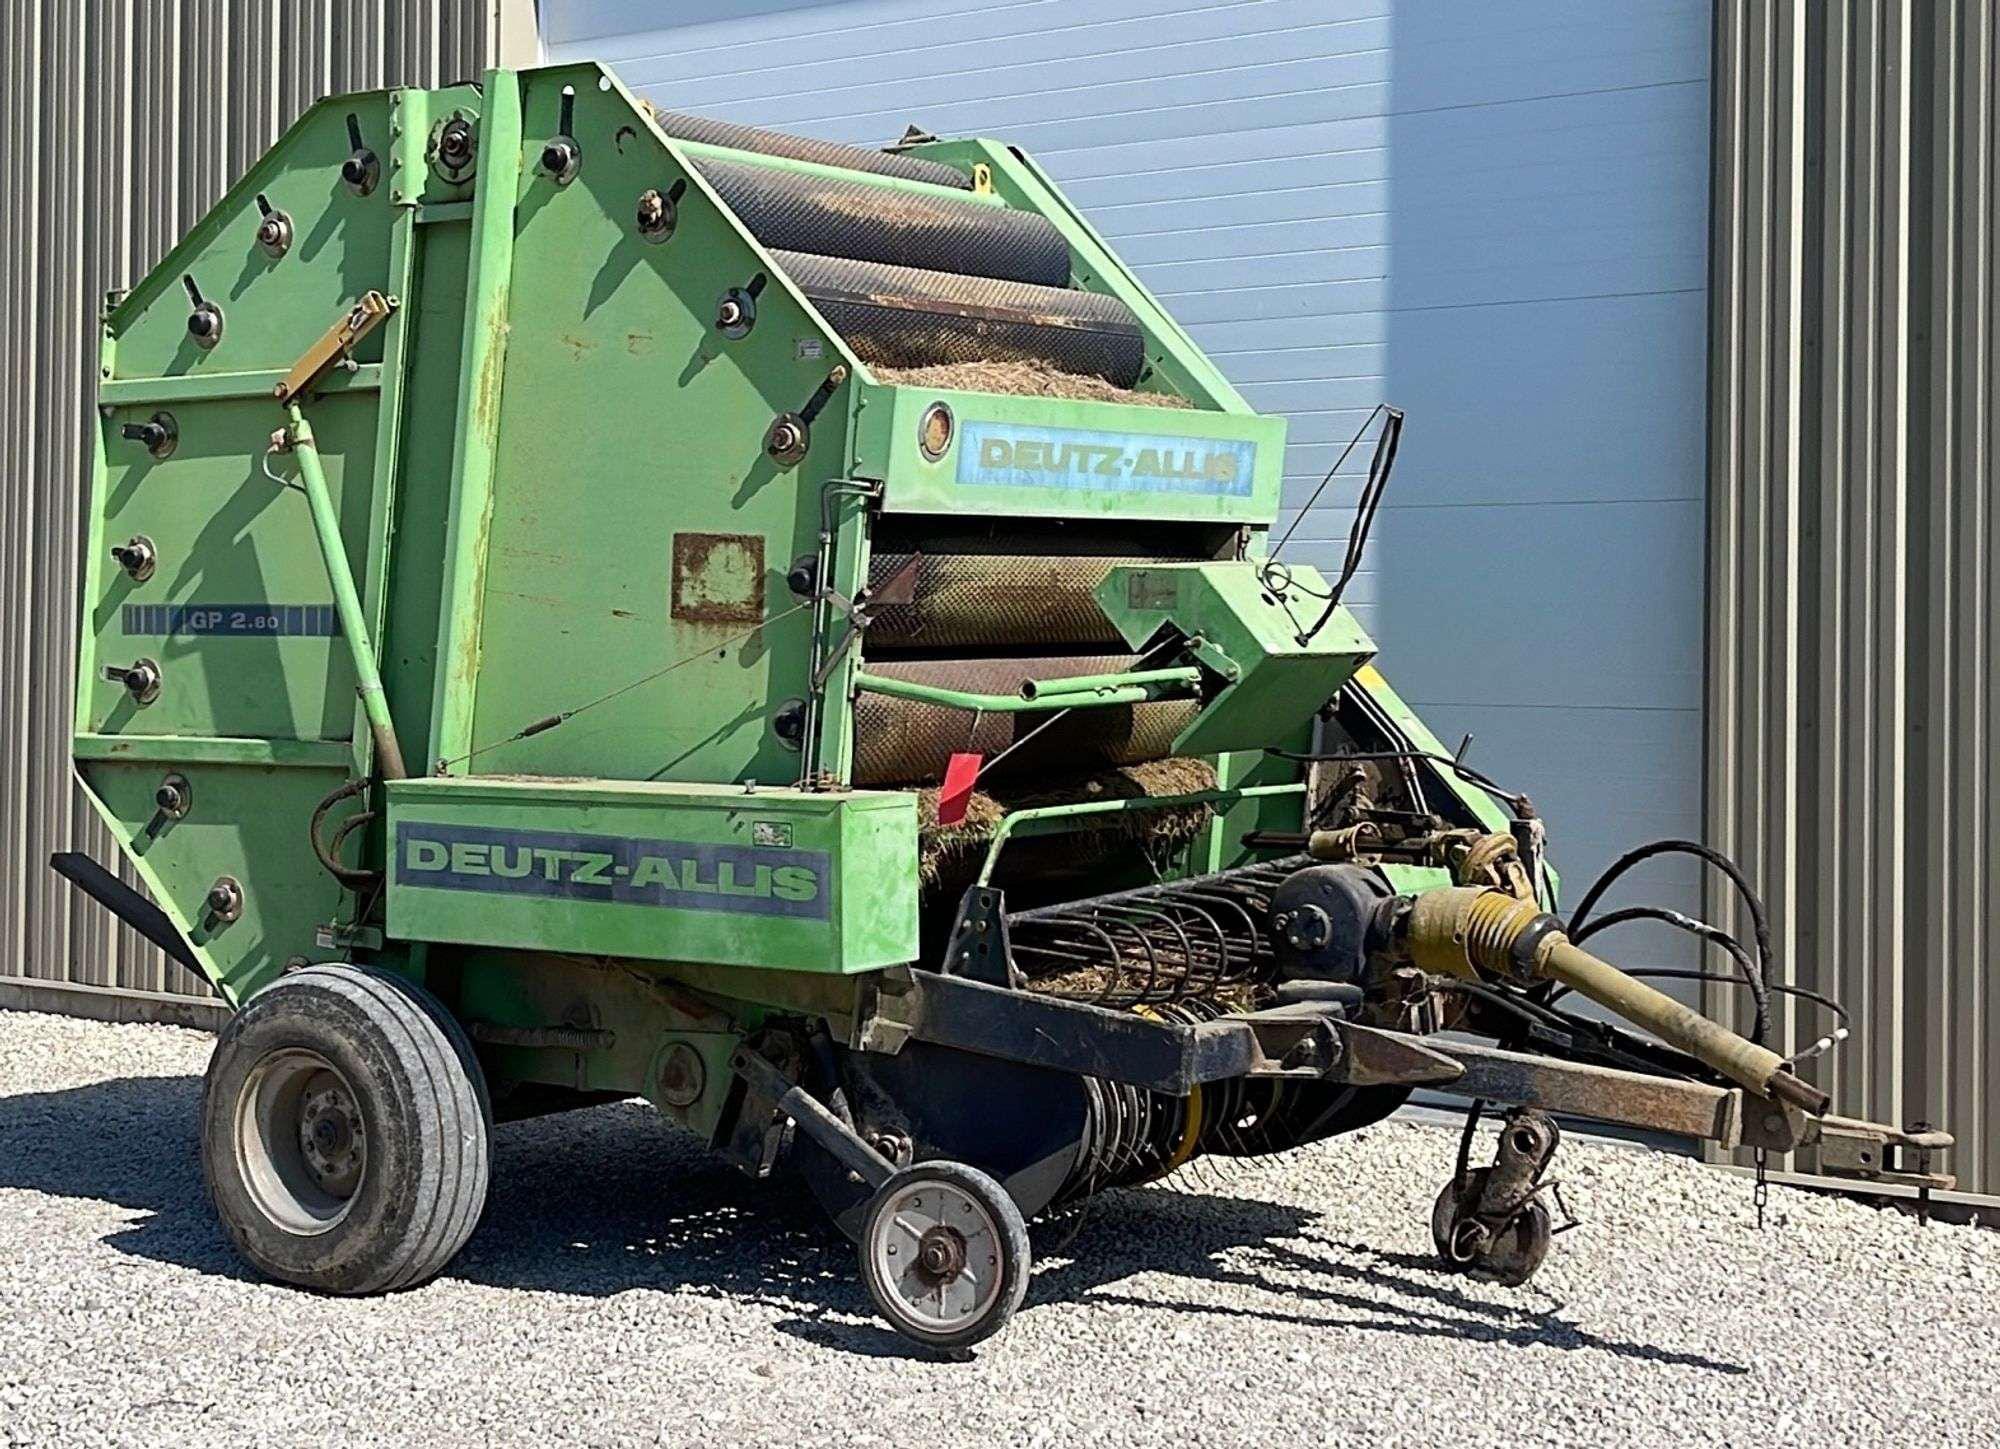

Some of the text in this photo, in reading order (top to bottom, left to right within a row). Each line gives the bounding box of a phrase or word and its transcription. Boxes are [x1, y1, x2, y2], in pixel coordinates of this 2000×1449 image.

[190, 611, 279, 629] GP 2.80
[406, 839, 818, 901] DEUTZ-ALLIS
